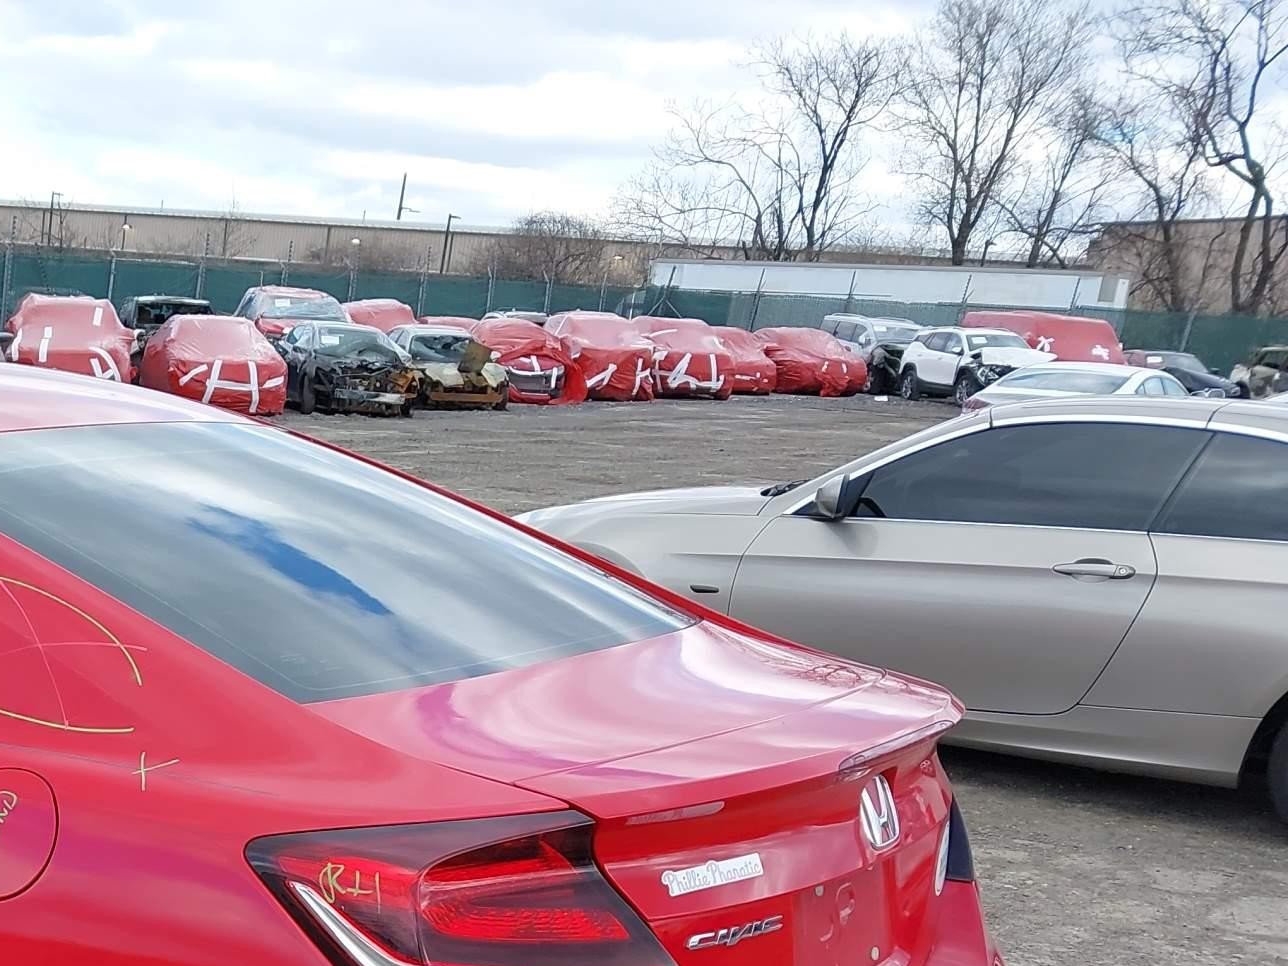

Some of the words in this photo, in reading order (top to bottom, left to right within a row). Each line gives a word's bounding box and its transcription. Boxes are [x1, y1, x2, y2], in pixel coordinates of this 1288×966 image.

[664, 872, 710, 894] Phillie
[705, 861, 762, 884] Phanatic
[688, 916, 784, 950] CIVIC
